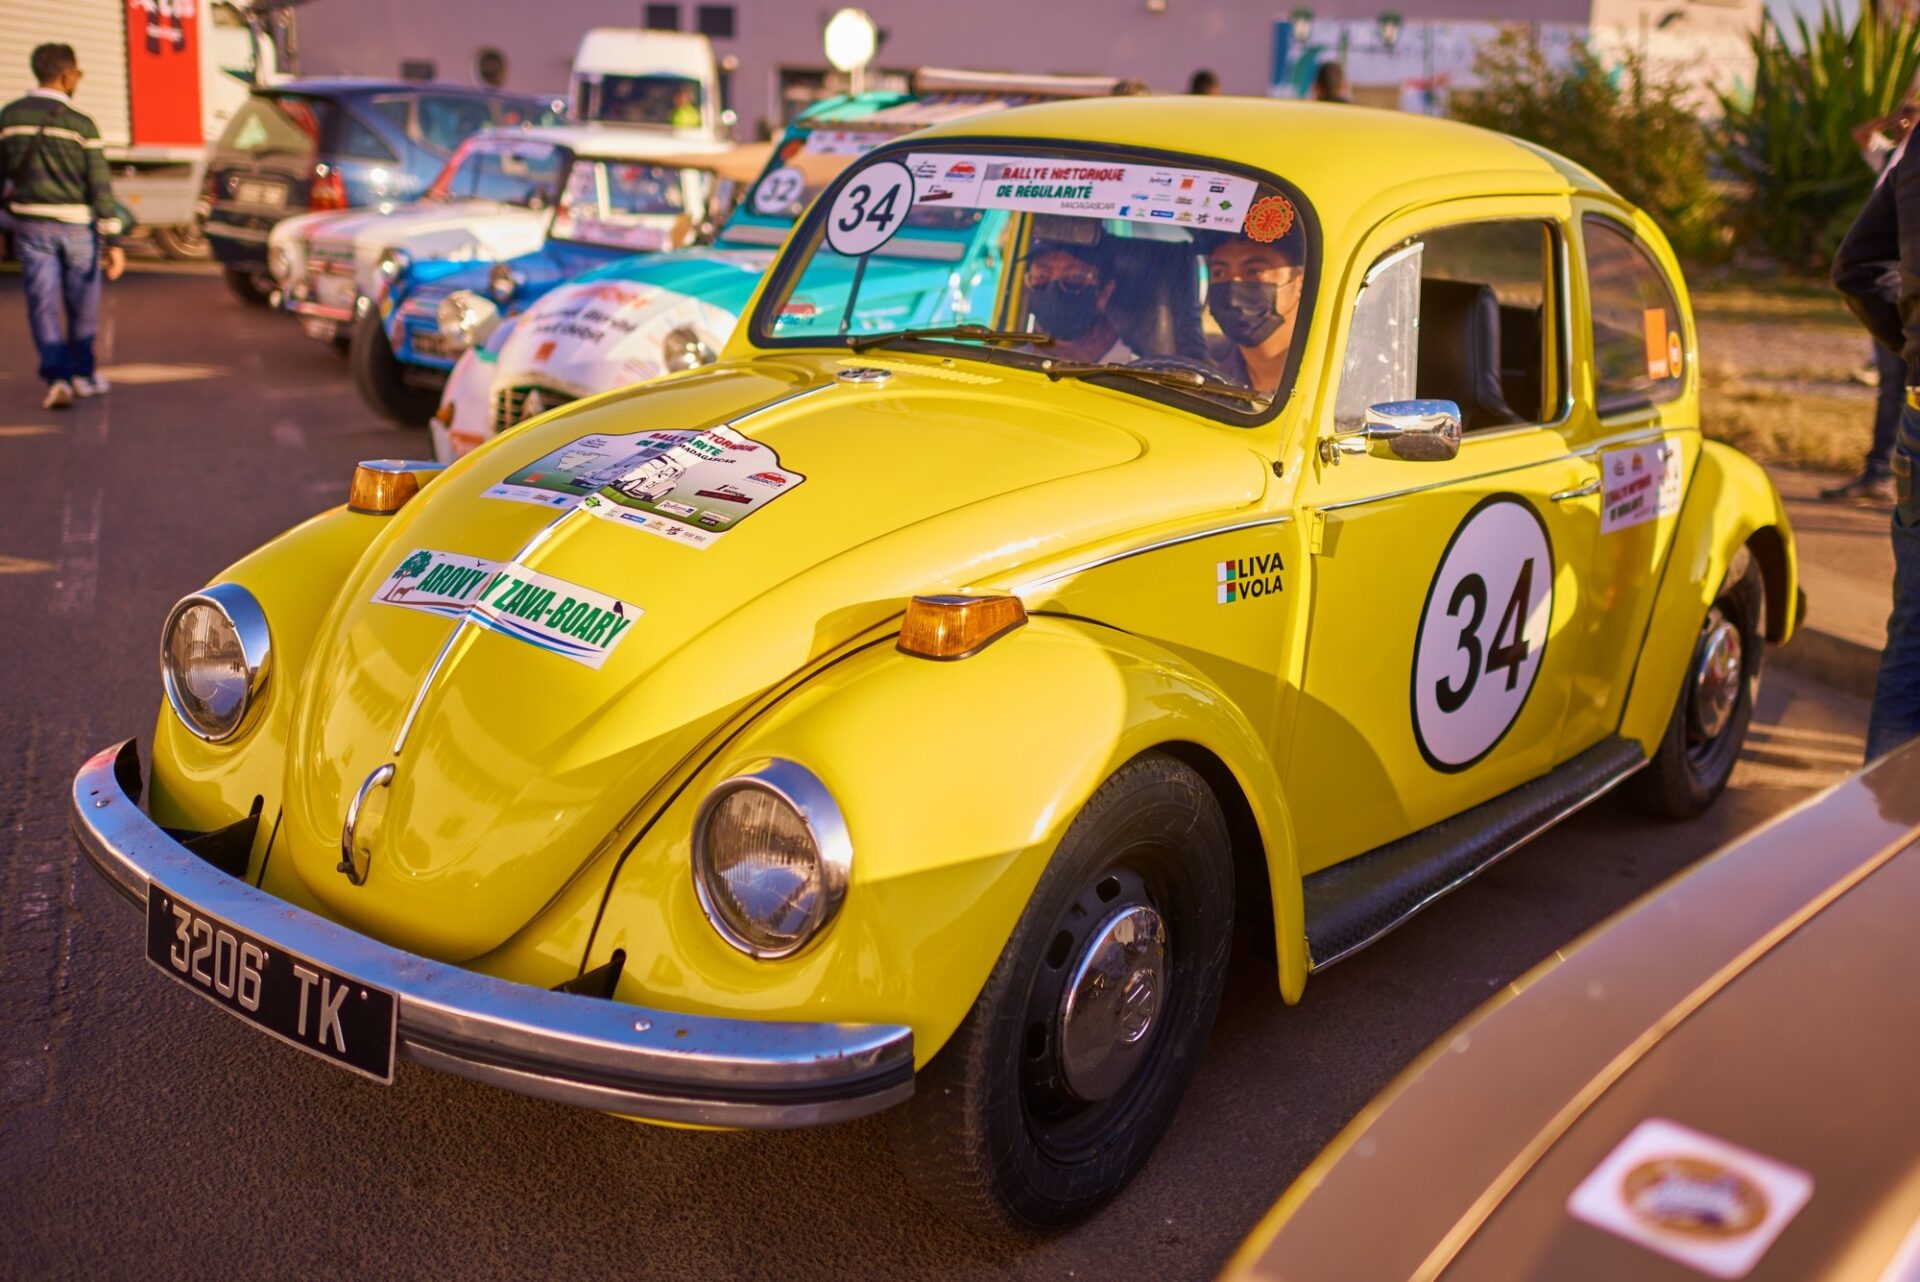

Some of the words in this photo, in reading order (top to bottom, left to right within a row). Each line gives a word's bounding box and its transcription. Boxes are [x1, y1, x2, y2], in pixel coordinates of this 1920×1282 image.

[1002, 167, 1048, 180] RALLYE
[1050, 167, 1125, 182] HISTORIQUE
[762, 176, 798, 202] 32
[996, 185, 1014, 198] DE
[1016, 180, 1094, 199] RÉGULARITÉ
[838, 184, 901, 232] 34
[1060, 201, 1116, 211] MADAGASCAR
[1238, 552, 1284, 579] LIVA
[1238, 575, 1283, 600] VOLA
[416, 563, 488, 600] AROVY
[492, 578, 631, 649] ZAVA-BOARY
[1435, 557, 1534, 714] 34
[171, 904, 263, 1012] 3206
[294, 965, 349, 1053] TK
